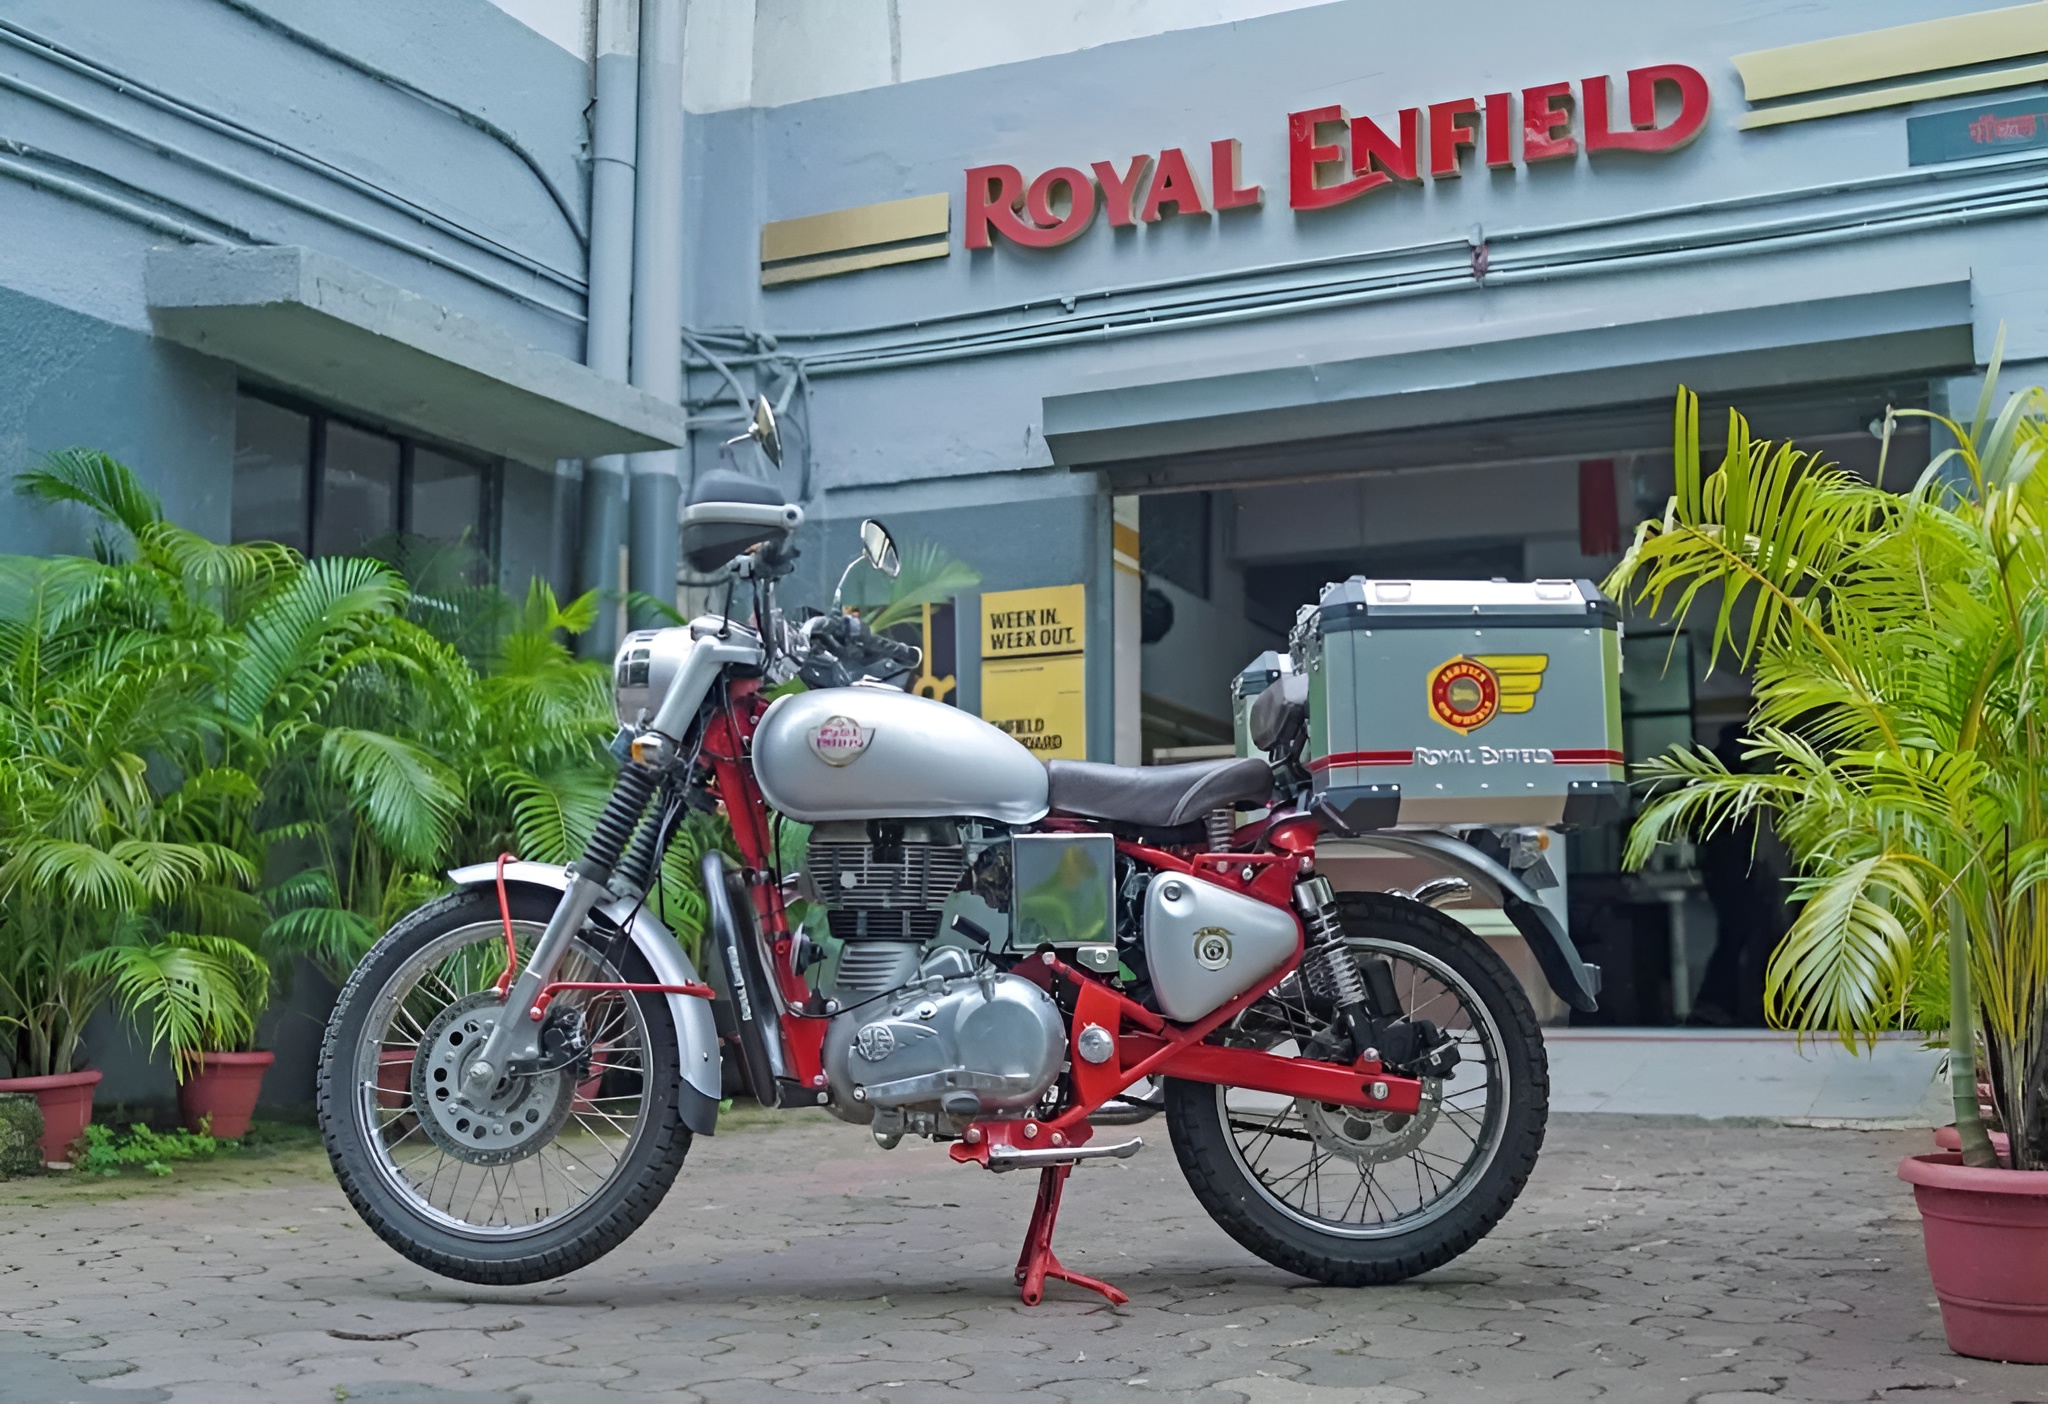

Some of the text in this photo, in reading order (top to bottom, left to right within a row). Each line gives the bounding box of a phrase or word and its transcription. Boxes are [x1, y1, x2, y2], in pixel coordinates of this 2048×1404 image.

[965, 64, 1710, 249] ROYAL ENFIELD
[990, 609, 1036, 630] WEEK
[990, 630, 1036, 650] WEEK
[1415, 746, 1476, 765] ROYAL
